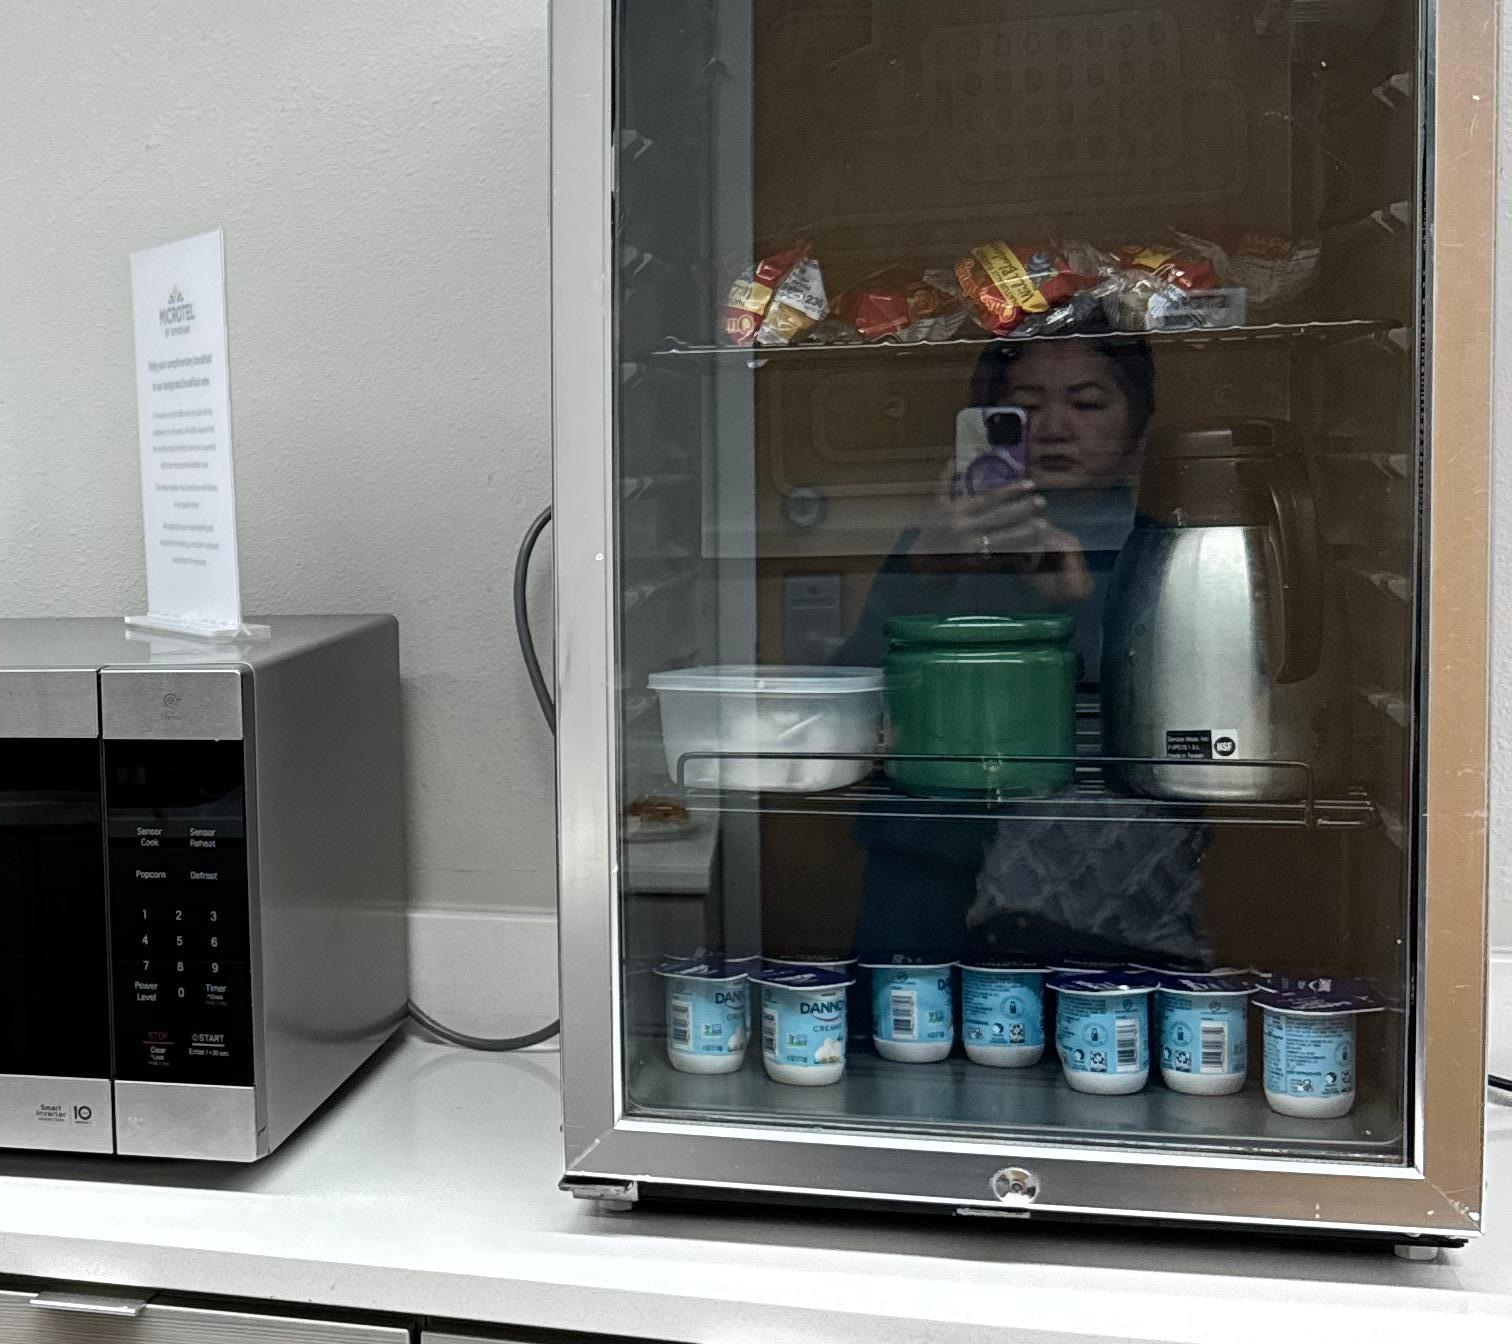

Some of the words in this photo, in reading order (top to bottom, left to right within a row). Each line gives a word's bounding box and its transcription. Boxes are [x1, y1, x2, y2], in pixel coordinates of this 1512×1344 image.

[1216, 741, 1232, 752] NSF
[136, 827, 162, 836] Sensor
[190, 828, 216, 837] Sensor
[140, 838, 159, 847] Cook
[190, 839, 216, 848] Reheat
[136, 870, 167, 880] Popcorn
[190, 871, 218, 880] Defrost
[142, 909, 147, 920] 1
[175, 910, 183, 921] 2
[209, 910, 217, 922] 3
[141, 934, 149, 945] 4
[176, 935, 183, 946] 5
[210, 936, 218, 948] 6
[143, 960, 150, 971] 7
[177, 961, 184, 972] 8
[211, 962, 219, 974] 9
[134, 981, 158, 990] Power
[205, 983, 227, 992] Timer
[136, 992, 157, 1001] Level
[177, 987, 185, 998] 0
[148, 1031, 169, 1040] STOP
[199, 1033, 224, 1042] START
[40, 1103, 62, 1111] Smart
[73, 1105, 92, 1120] 10
